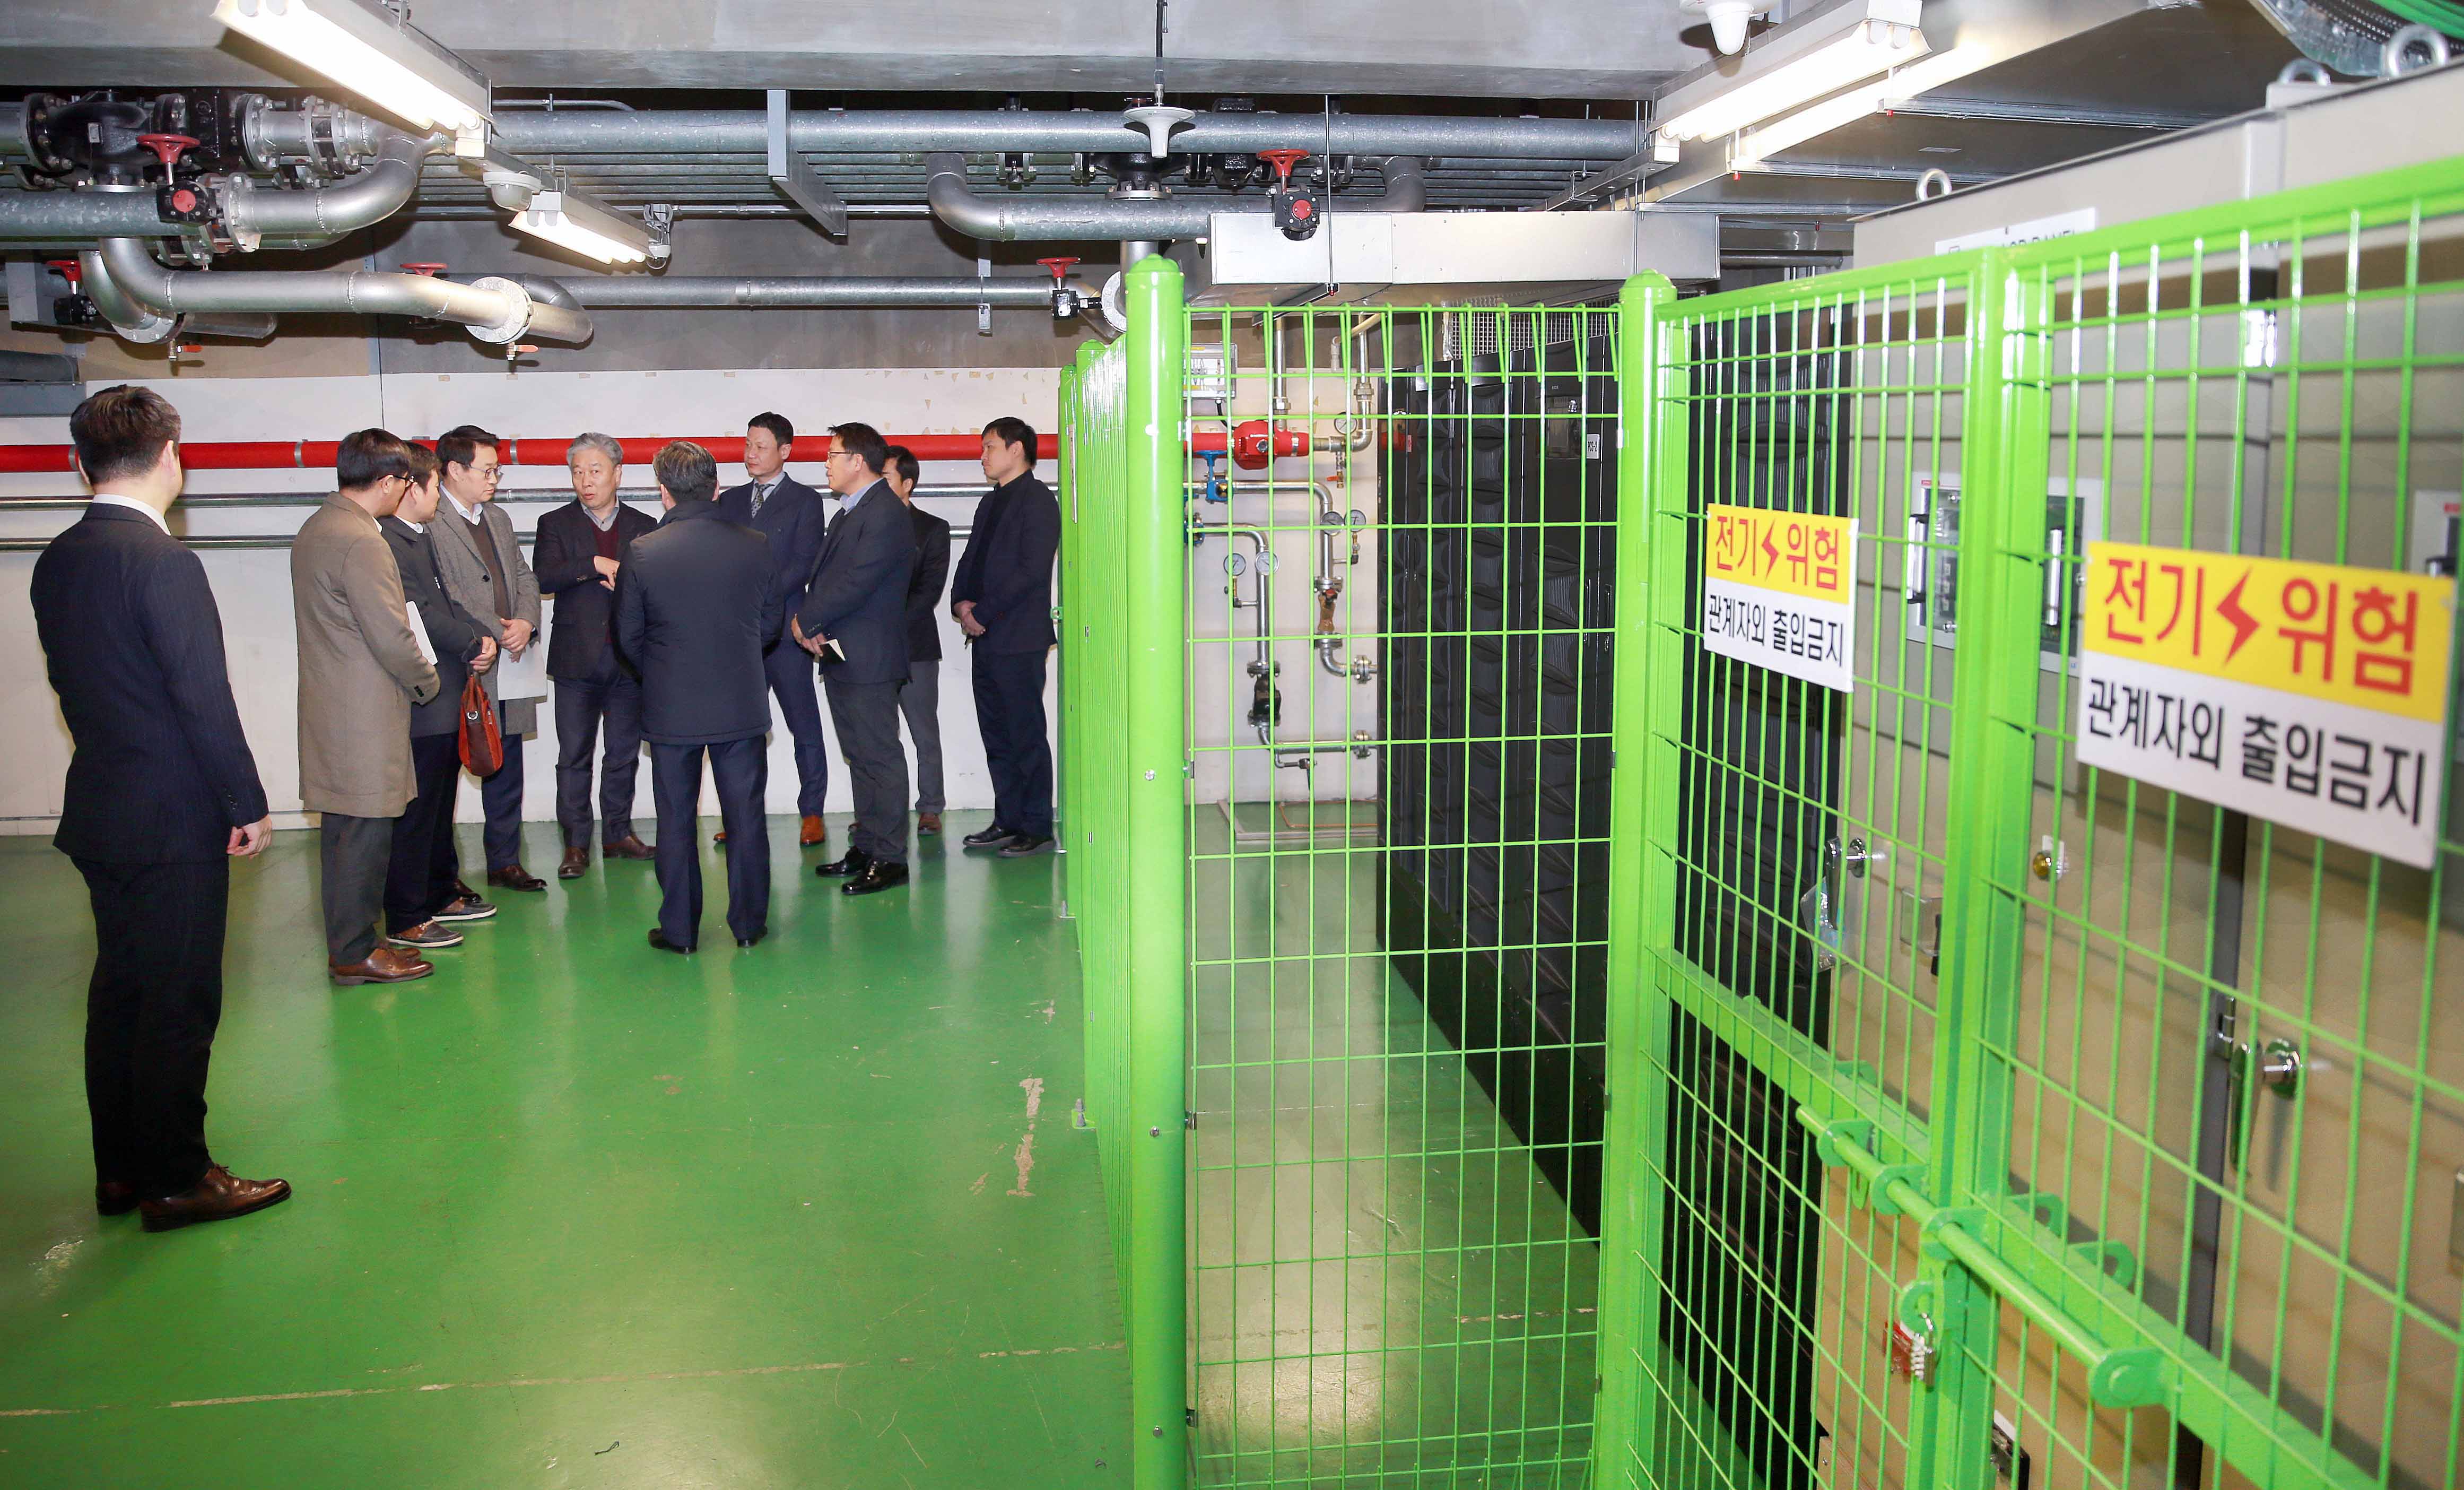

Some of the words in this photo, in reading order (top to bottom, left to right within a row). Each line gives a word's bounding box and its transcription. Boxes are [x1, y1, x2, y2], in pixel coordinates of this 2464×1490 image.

[1716, 516, 1757, 577] 전기
[1787, 523, 1839, 591] 위험
[1709, 594, 1766, 646] 관계자외
[1773, 610, 1843, 668] 출입금지
[2105, 558, 2204, 657] 전기
[2278, 577, 2418, 696] 위험
[2088, 677, 2225, 770] 관계자외
[2242, 715, 2425, 827] 출입금지
